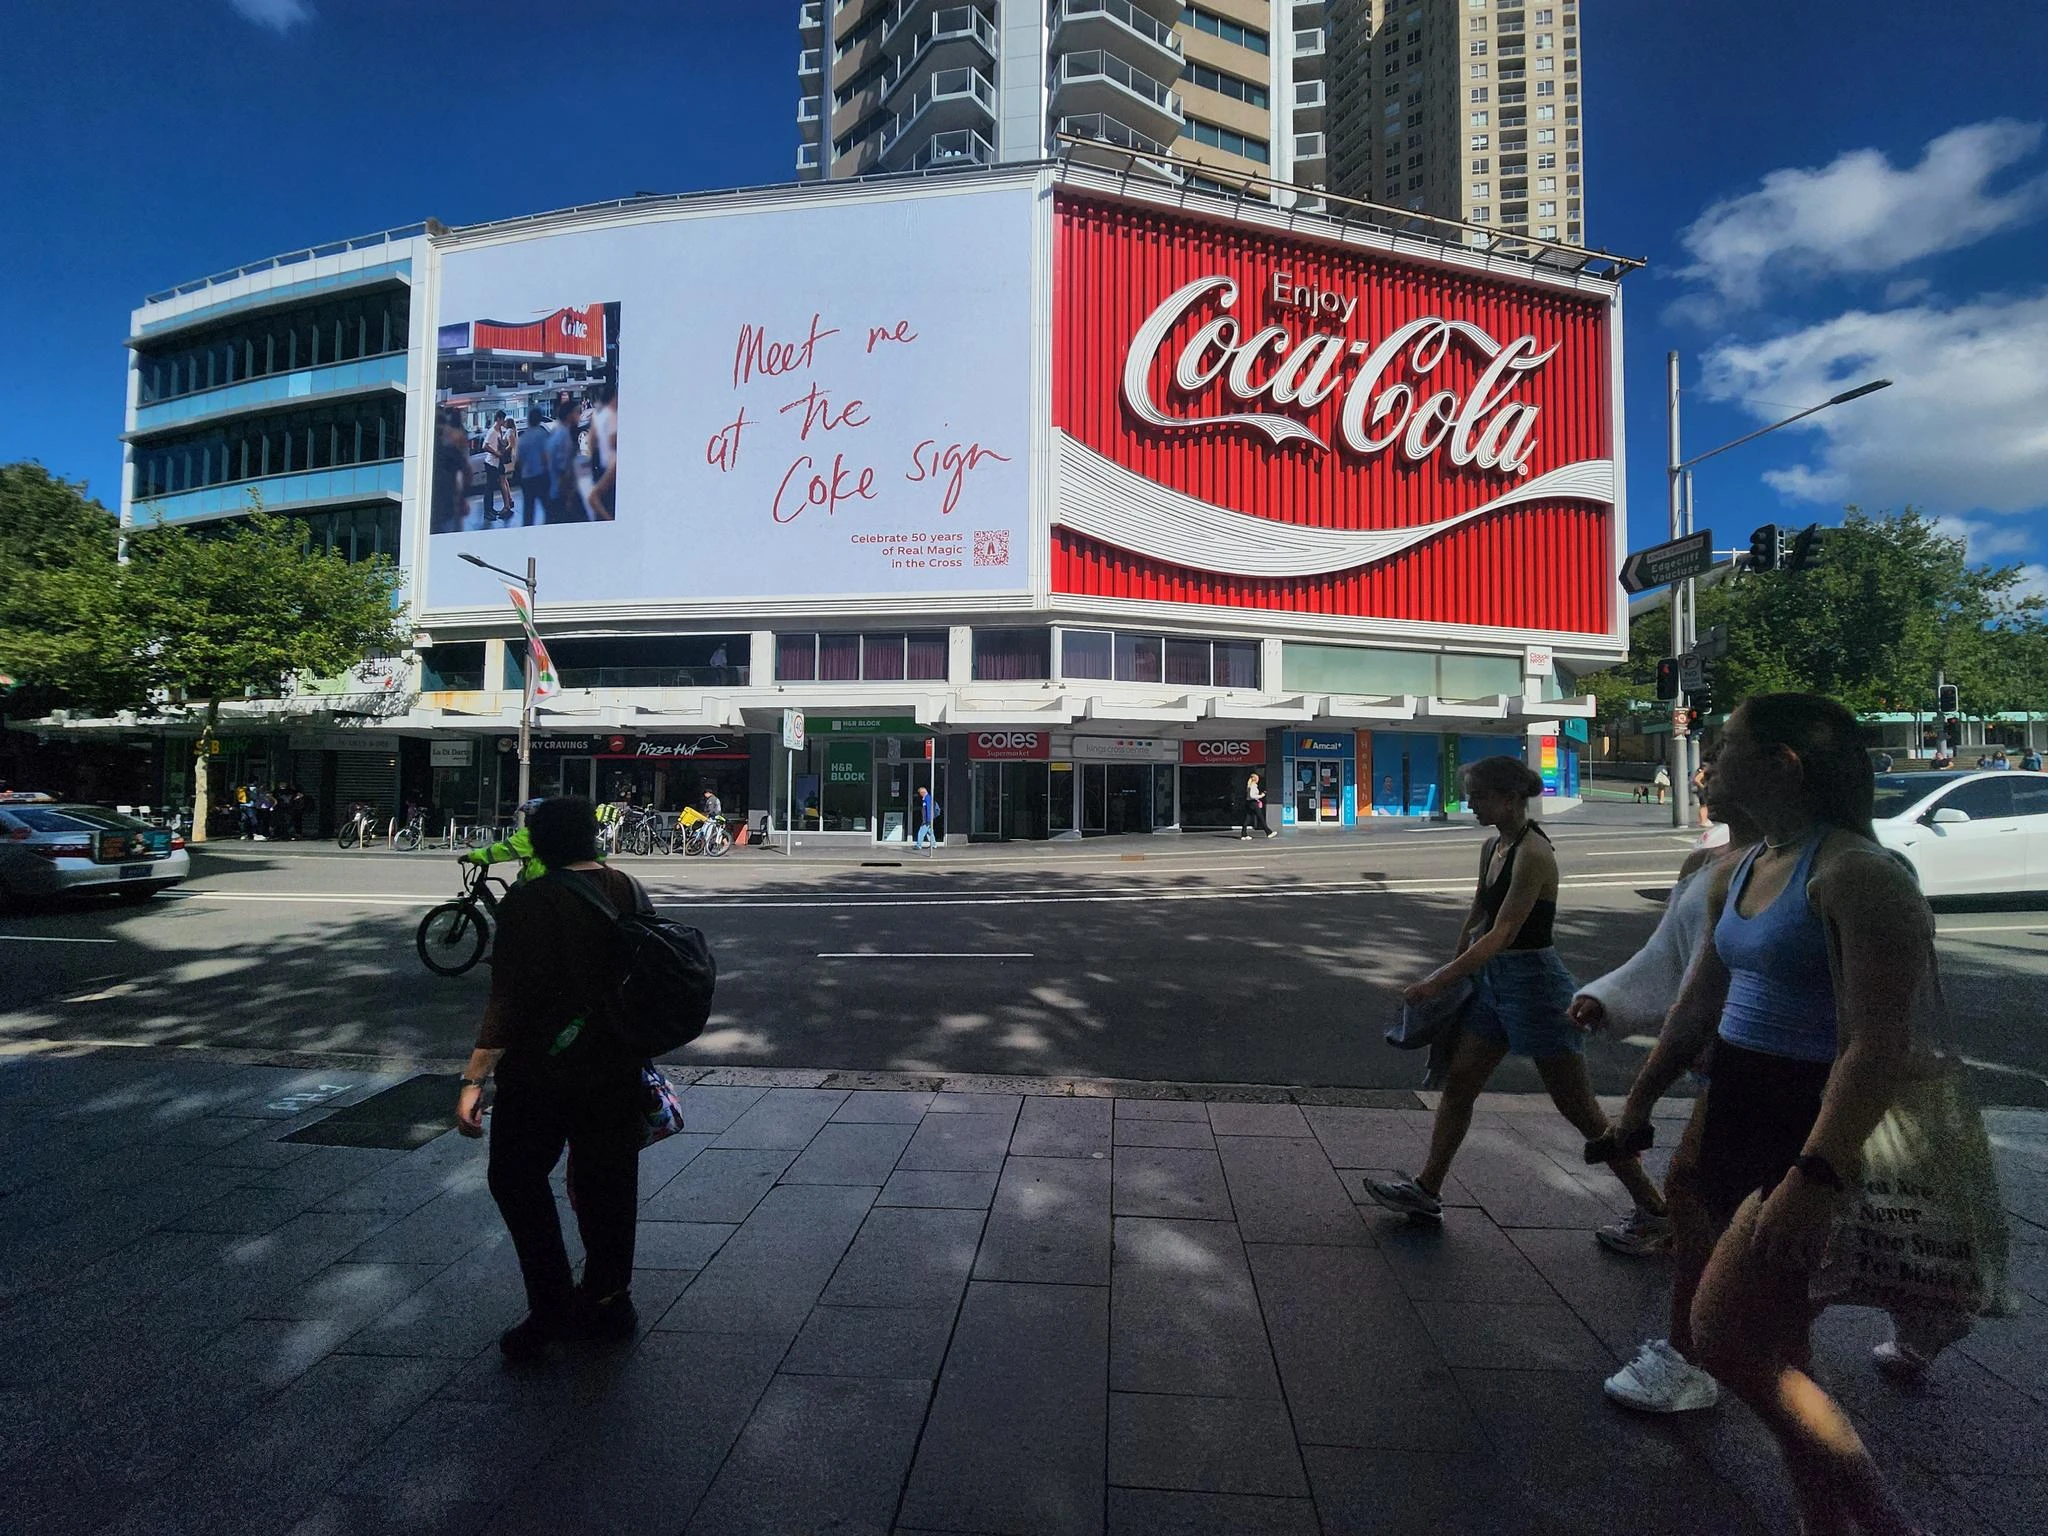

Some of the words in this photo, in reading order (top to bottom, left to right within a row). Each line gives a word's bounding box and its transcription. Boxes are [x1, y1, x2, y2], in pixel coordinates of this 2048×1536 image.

[1273, 272, 1358, 323] Enjoy
[733, 313, 840, 389] Meet
[867, 320, 918, 353] me
[1123, 275, 1562, 474] Coca-Cola
[706, 406, 759, 472] at
[773, 453, 878, 523] Coke
[906, 424, 1012, 514] sign
[851, 533, 908, 544] Celebrate
[911, 533, 927, 542] 50
[930, 533, 963, 544] years
[882, 546, 894, 556] of
[897, 545, 924, 555] Real
[891, 559, 902, 568] in
[906, 558, 925, 568] the
[929, 558, 963, 568] Cross
[1651, 551, 1700, 573] Edgecliff
[1651, 564, 1701, 584] Vaucluse
[513, 741, 543, 749] SKY
[544, 741, 589, 749] CRAVINGS
[636, 742, 673, 756] Pizza
[674, 743, 699, 756] Hut
[978, 733, 1038, 749] coles
[1198, 741, 1250, 755] coles
[831, 763, 853, 772] H&R
[831, 772, 866, 781] BLOCK
[1859, 1203, 1923, 1224] Never
